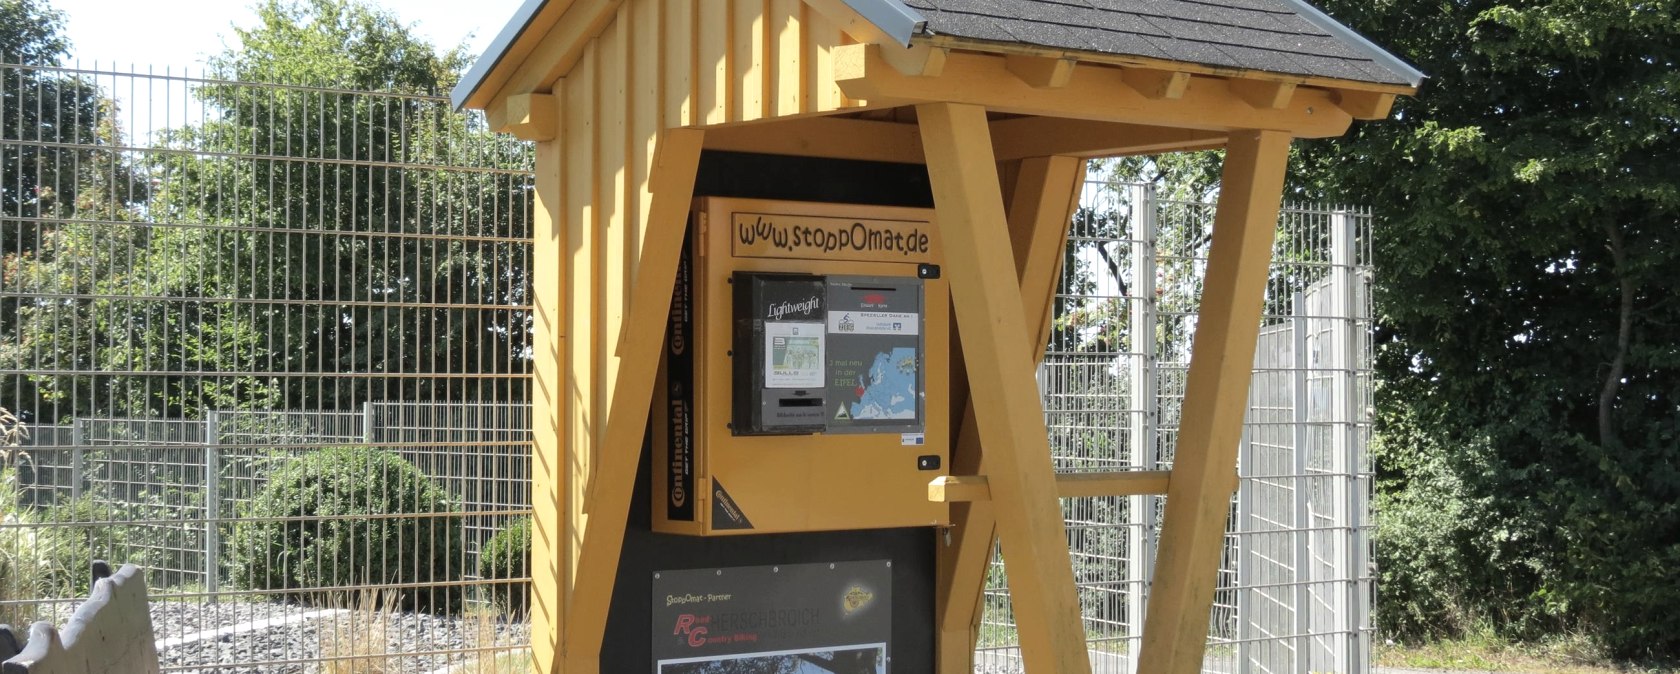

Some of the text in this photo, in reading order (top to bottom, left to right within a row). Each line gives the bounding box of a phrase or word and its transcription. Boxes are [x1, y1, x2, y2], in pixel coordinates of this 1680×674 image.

[739, 216, 929, 256] www.stoppOmat.de
[767, 295, 820, 320] Lightweight
[671, 399, 686, 507] Continental
[707, 594, 732, 603] Partner
